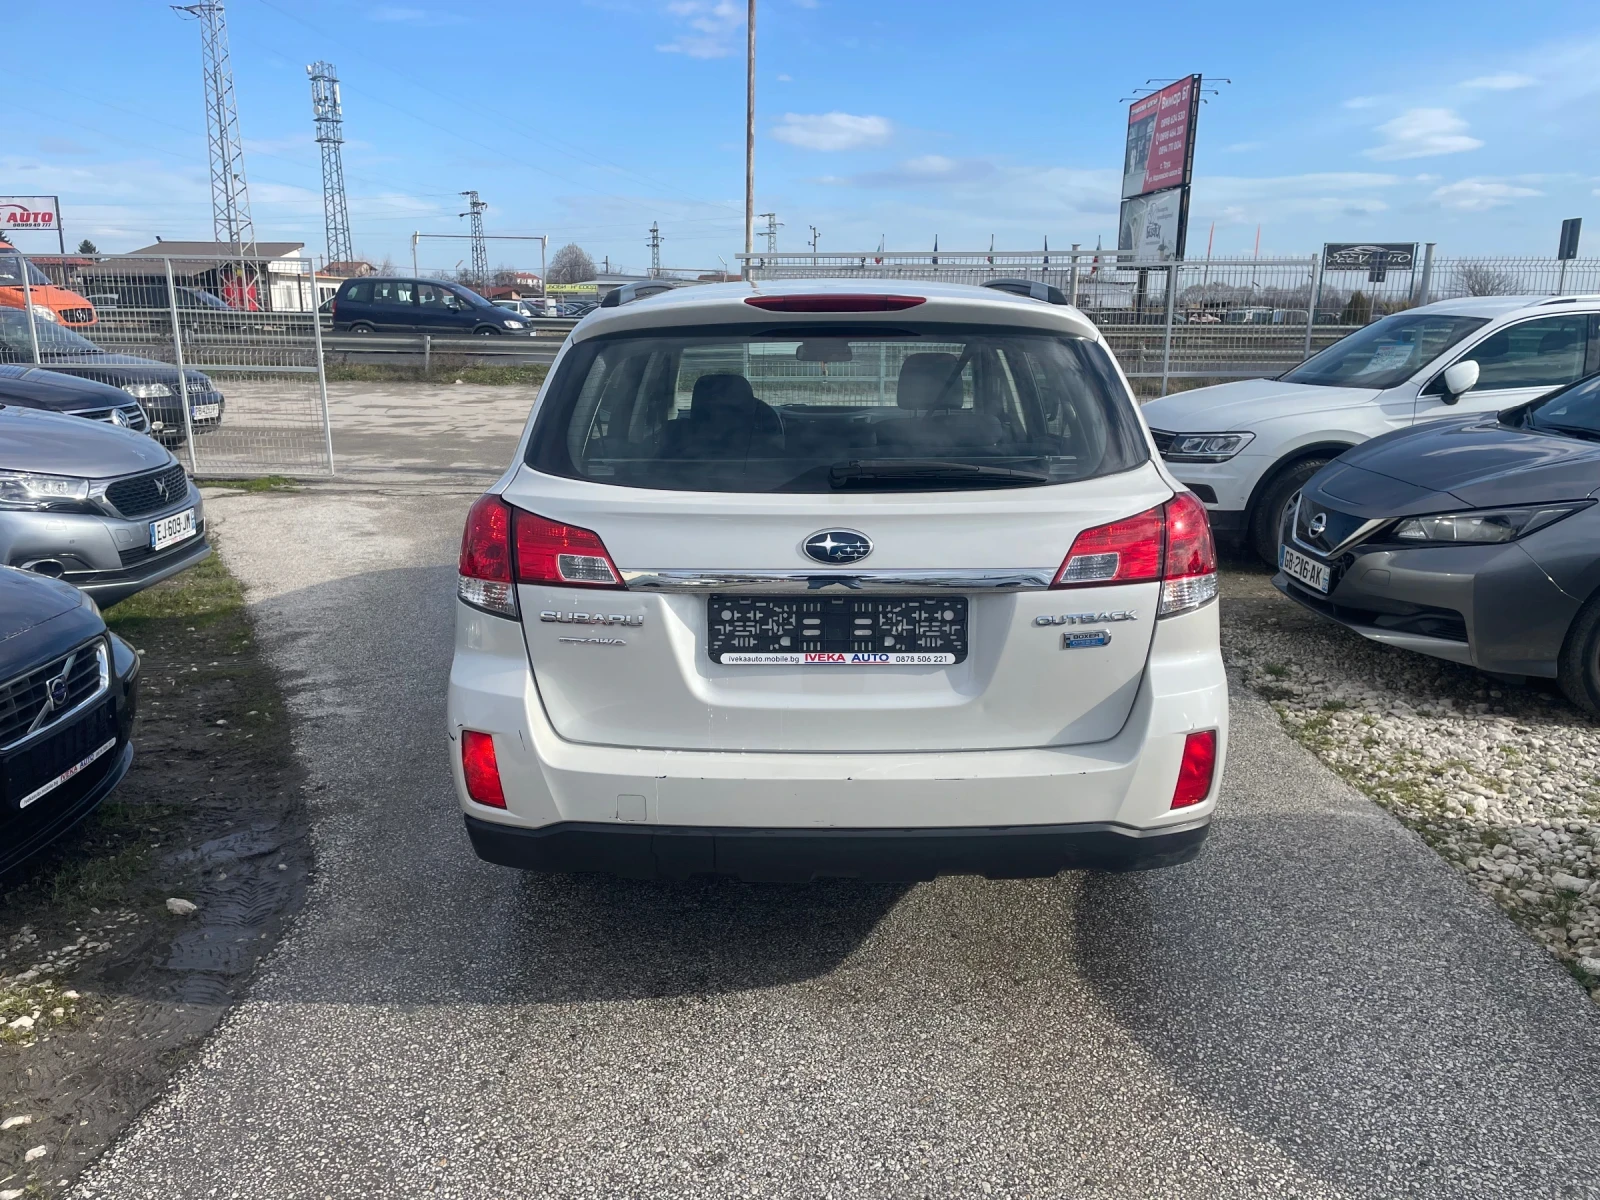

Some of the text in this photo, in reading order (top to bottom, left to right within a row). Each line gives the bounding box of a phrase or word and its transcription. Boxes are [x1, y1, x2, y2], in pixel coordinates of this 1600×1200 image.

[6, 212, 53, 223] AUTO
[540, 610, 644, 627] SUBARU
[1035, 609, 1138, 626] OUTBACK
[728, 655, 800, 664] ivekaauto.mobile.bg
[804, 653, 846, 662] IVEKA
[851, 653, 889, 662] AUTO
[80, 754, 95, 769] AUTO
